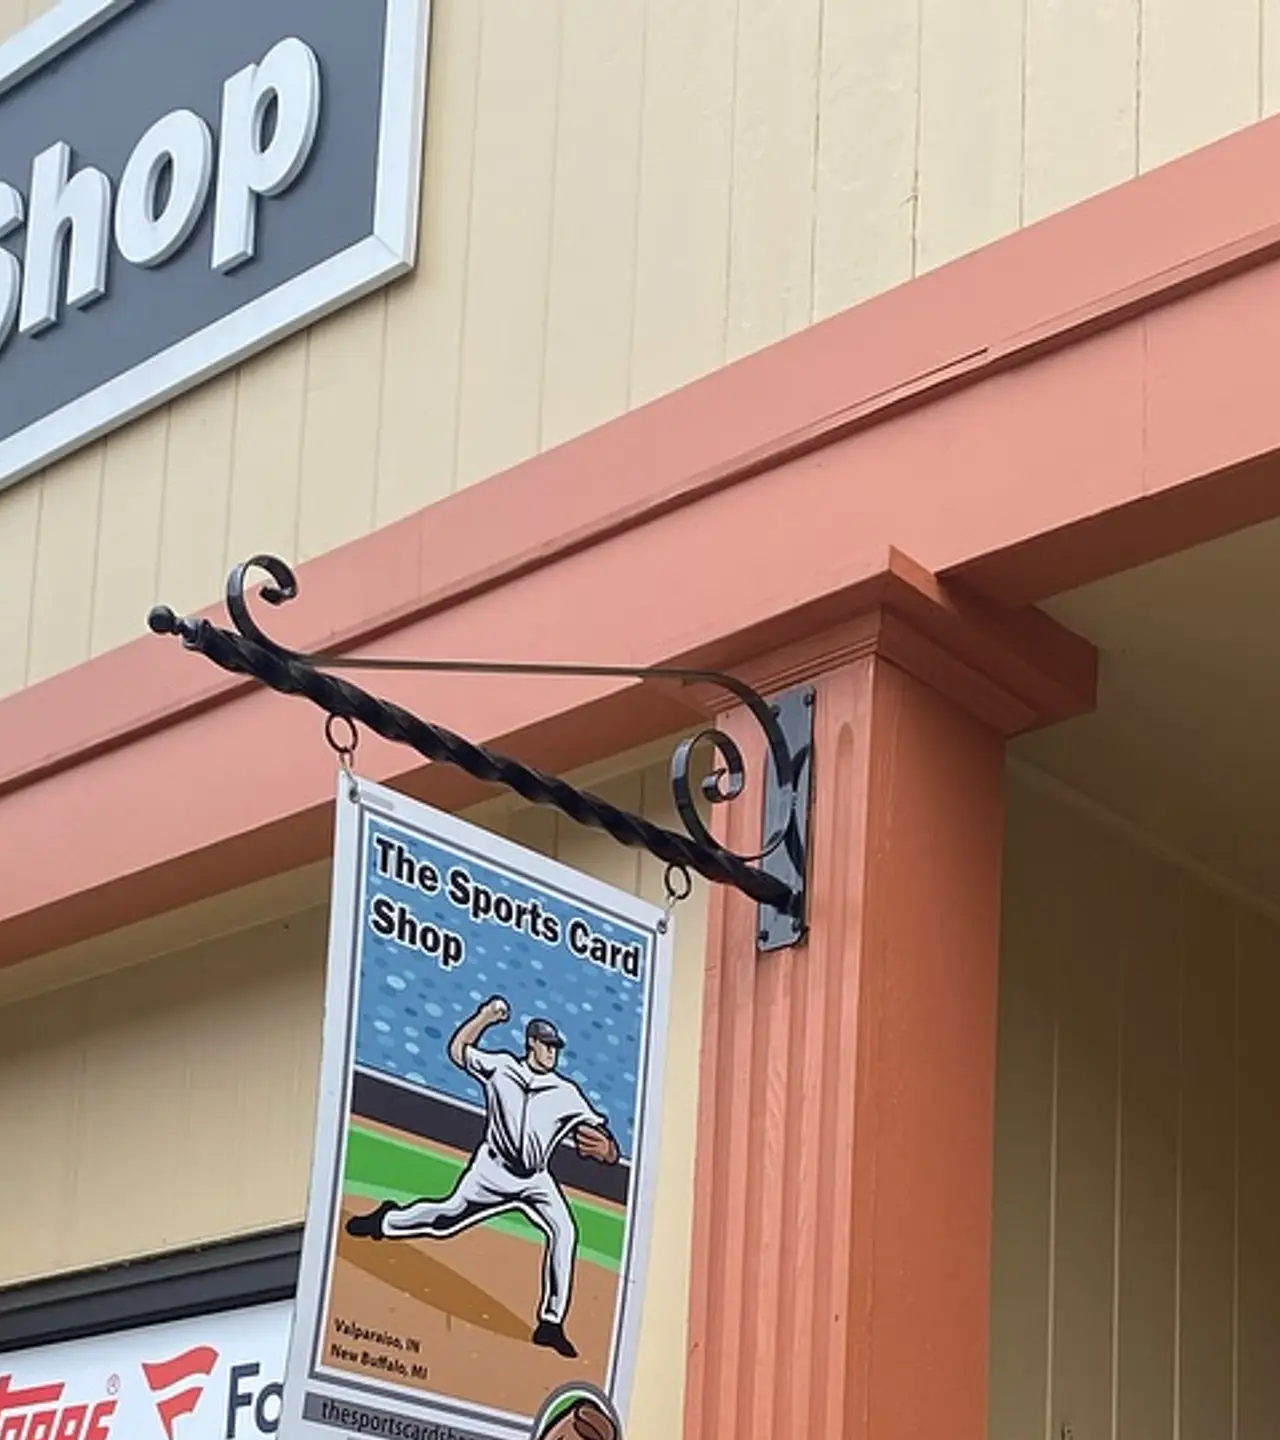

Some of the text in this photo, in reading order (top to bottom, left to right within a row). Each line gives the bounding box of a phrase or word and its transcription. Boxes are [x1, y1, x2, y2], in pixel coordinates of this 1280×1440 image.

[371, 900, 463, 967] Shop
[375, 836, 642, 977] The Sports Card
[330, 1344, 429, 1380] New Buffalo, MI
